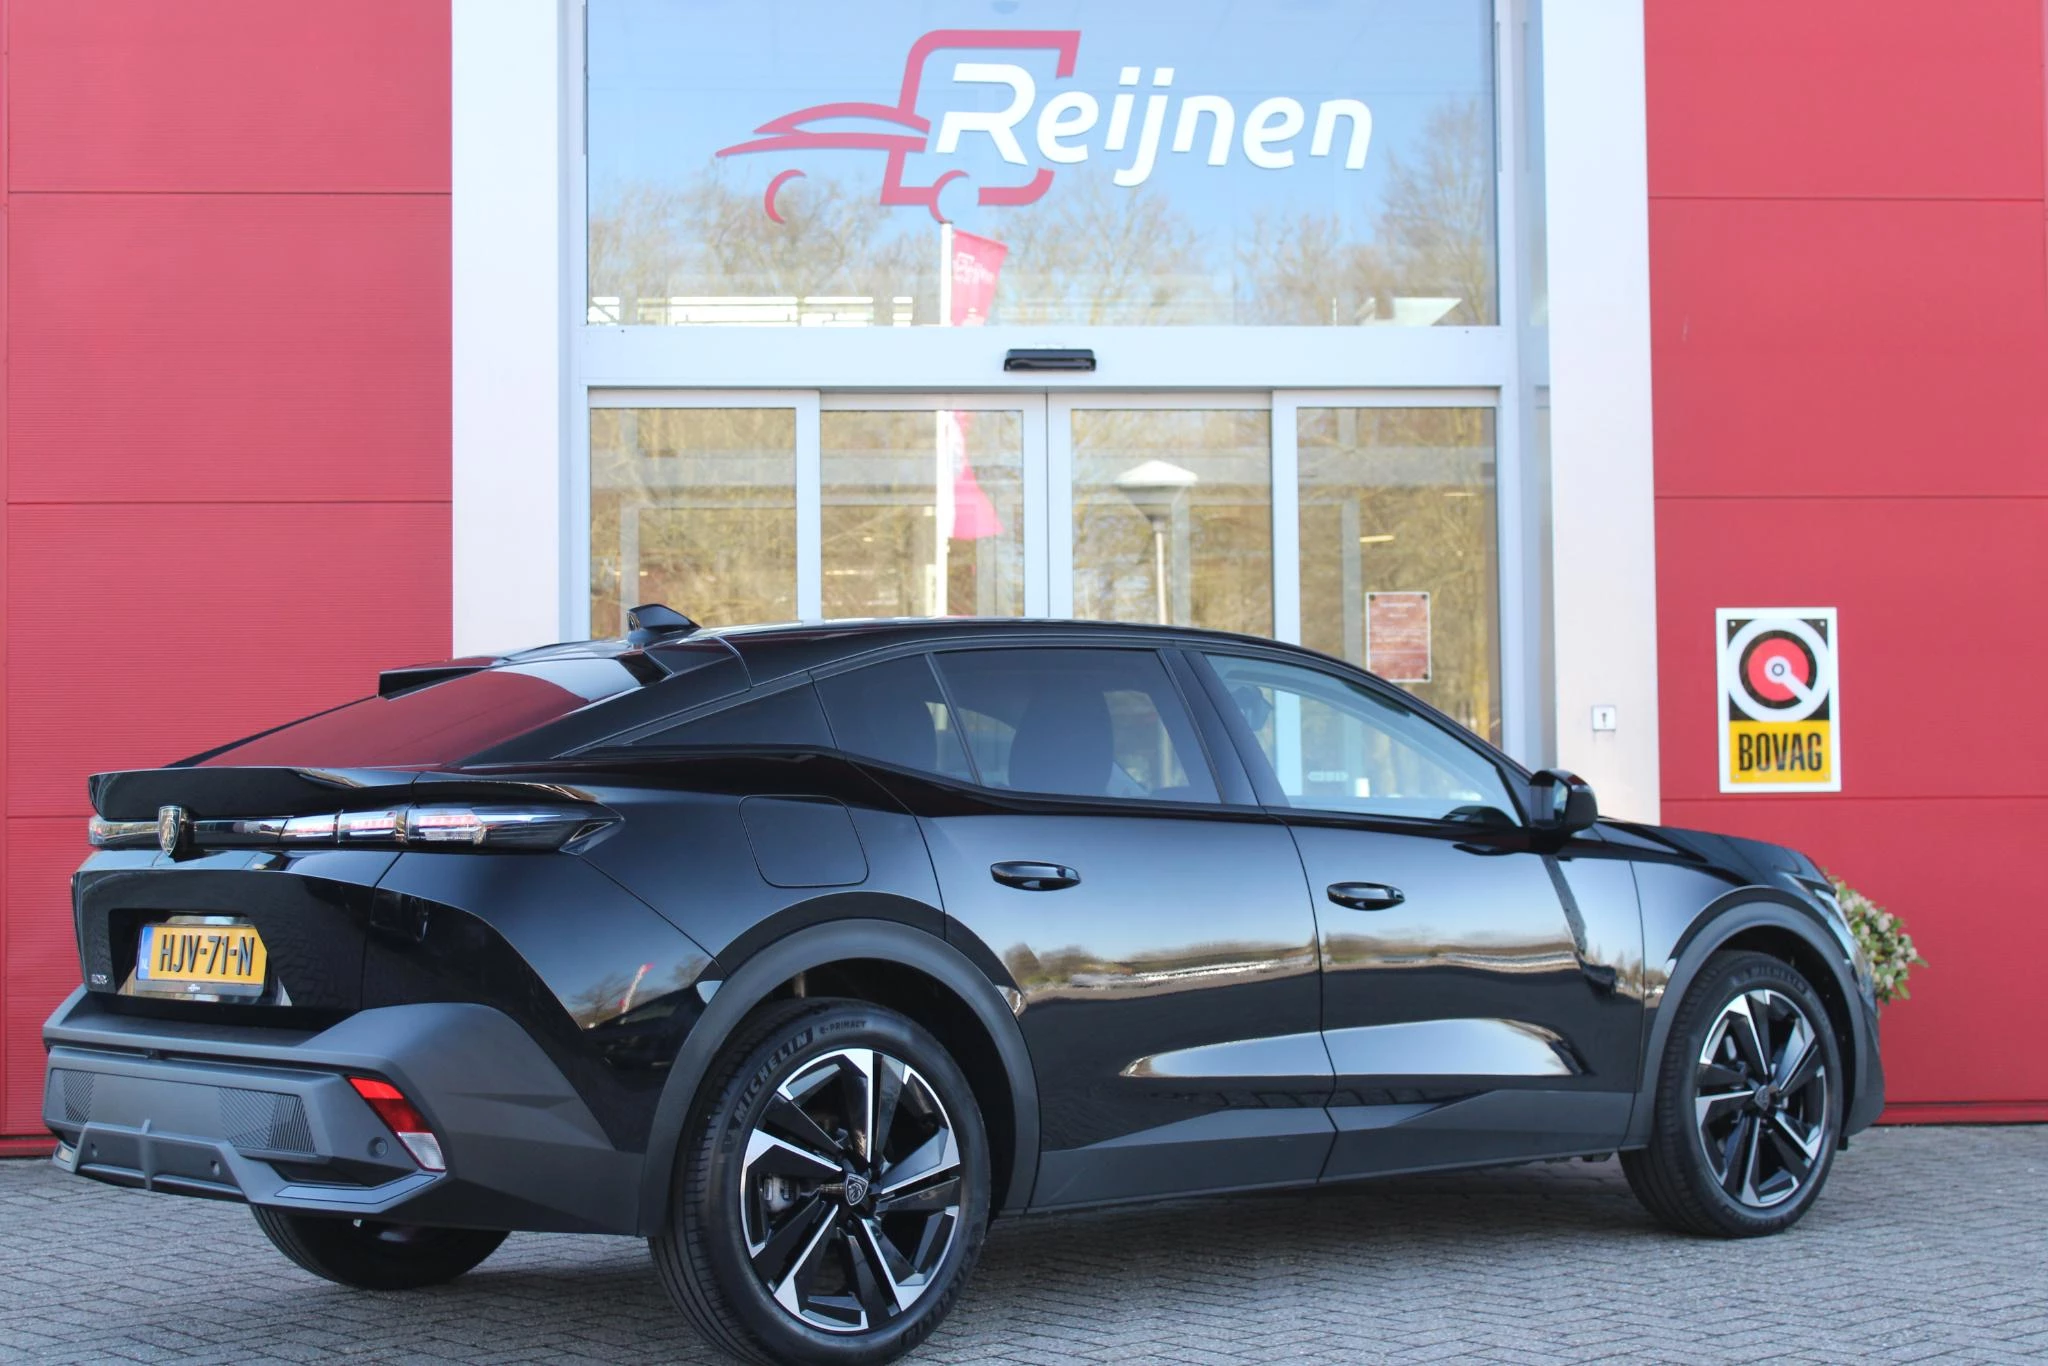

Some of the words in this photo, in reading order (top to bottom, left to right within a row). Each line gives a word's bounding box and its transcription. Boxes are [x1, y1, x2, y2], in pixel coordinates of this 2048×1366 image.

[935, 62, 1373, 188] Reijnen
[1738, 732, 1822, 771] BOVAG
[159, 934, 255, 976] HJV-71-N
[733, 1030, 810, 1123] MICHELIN
